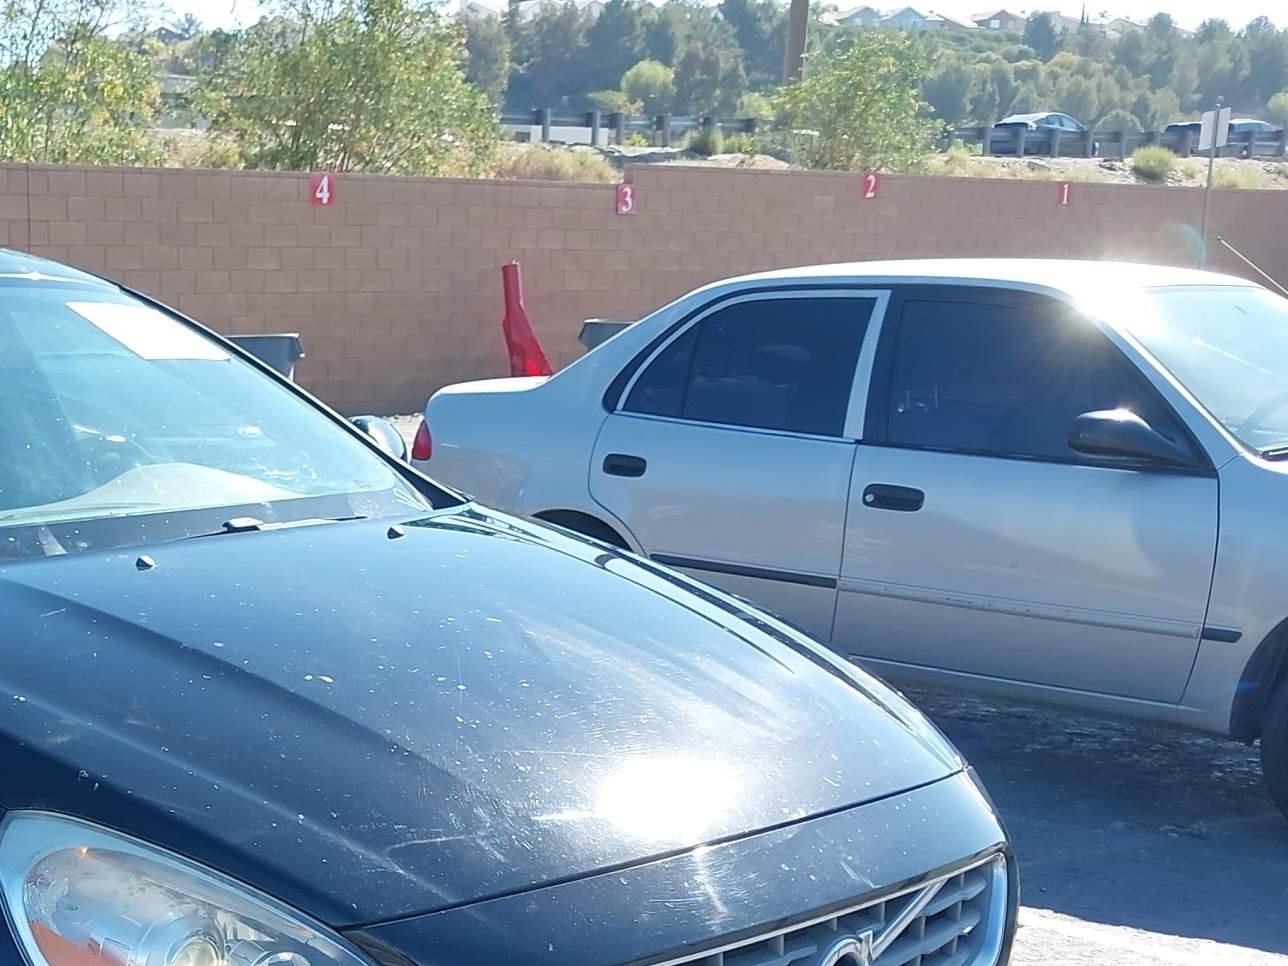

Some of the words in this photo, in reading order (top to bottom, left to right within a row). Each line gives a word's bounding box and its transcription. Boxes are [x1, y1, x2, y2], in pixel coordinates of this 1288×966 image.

[315, 174, 330, 205] 4
[621, 185, 633, 213] 3
[864, 174, 876, 199] 2
